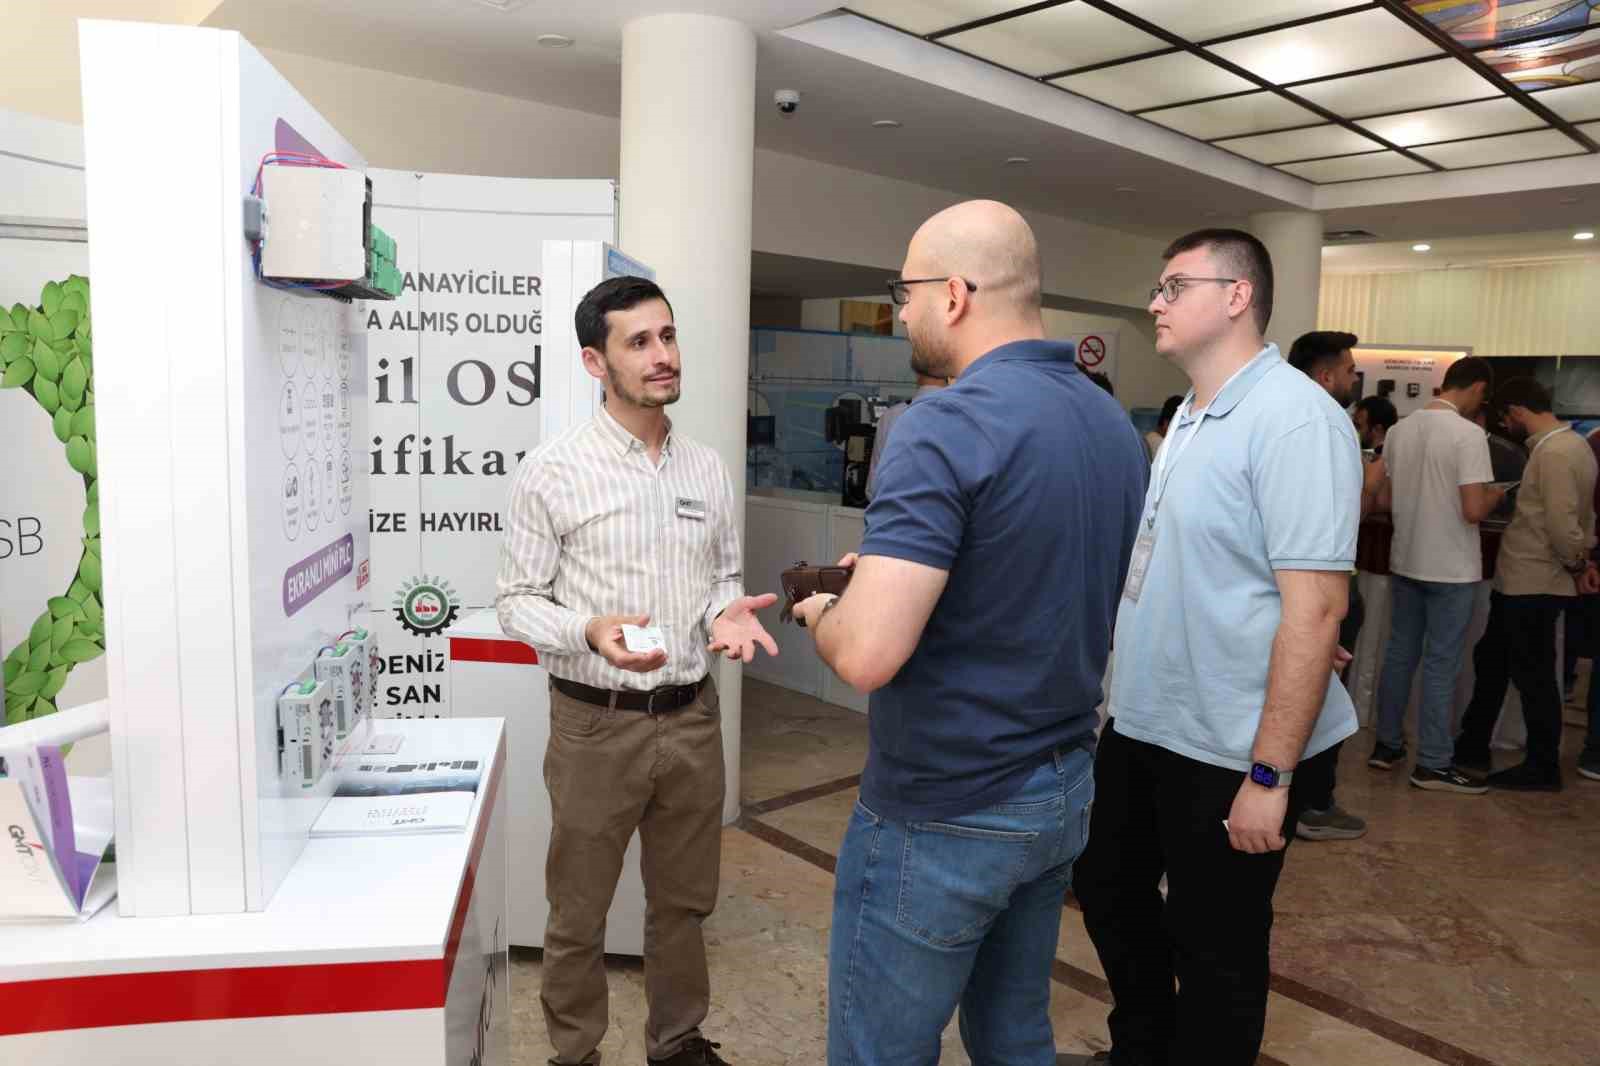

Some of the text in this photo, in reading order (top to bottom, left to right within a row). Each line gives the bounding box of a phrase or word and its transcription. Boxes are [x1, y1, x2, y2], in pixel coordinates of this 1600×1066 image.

[401, 270, 541, 296] ANAYİCİLER
[367, 309, 542, 335] A ALMIŞ OLDUĞ
[369, 509, 503, 532] İZE HAYIRL
[386, 684, 441, 705] SAN
